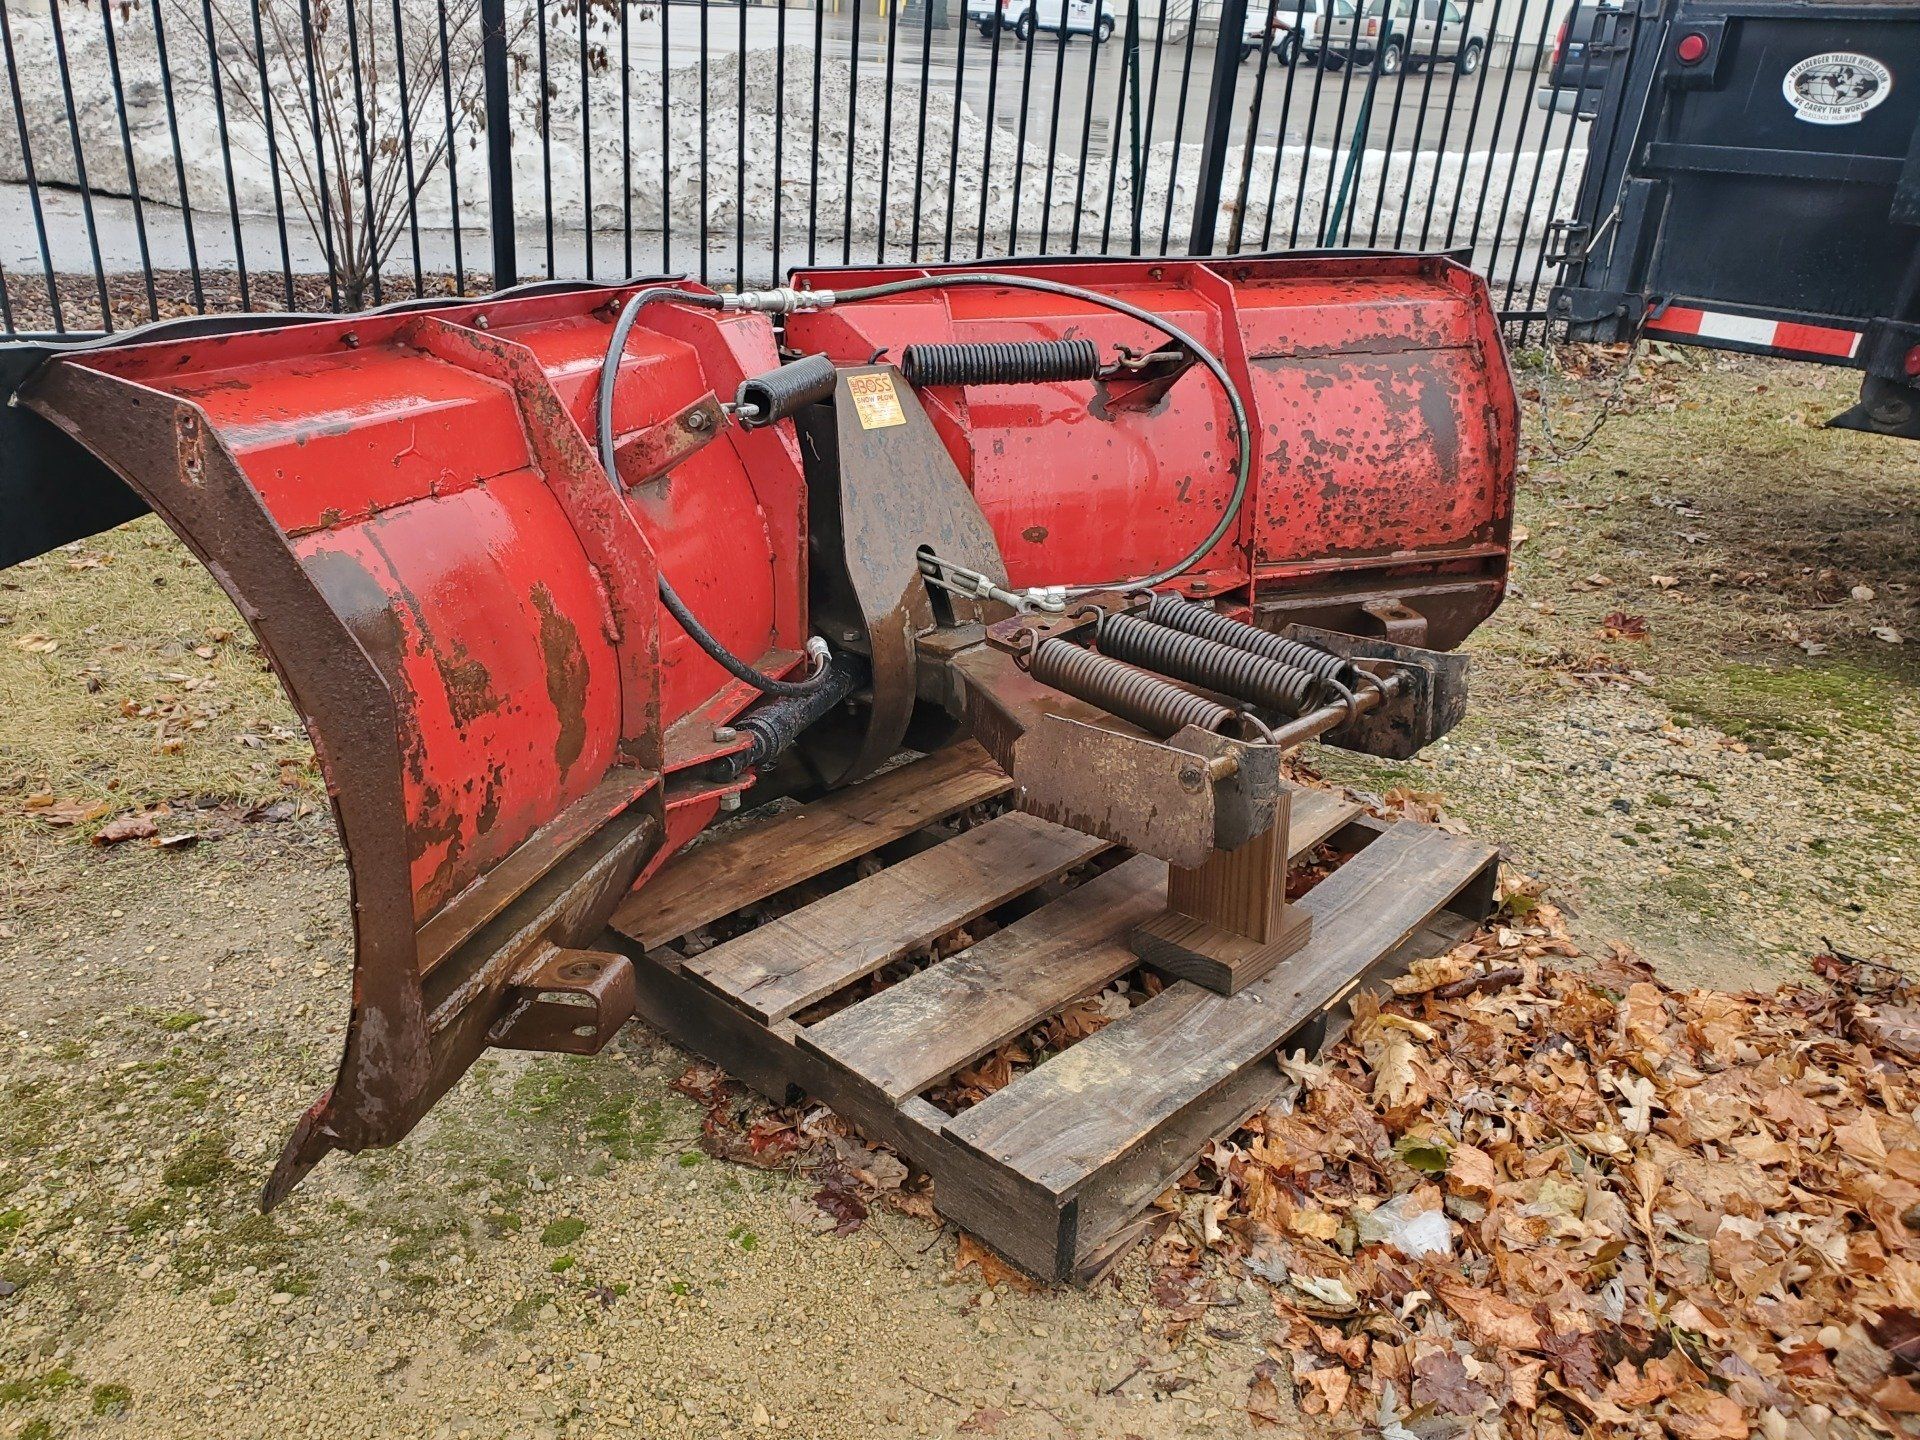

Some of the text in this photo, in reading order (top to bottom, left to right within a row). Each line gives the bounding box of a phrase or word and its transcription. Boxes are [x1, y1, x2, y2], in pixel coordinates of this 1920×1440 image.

[1831, 54, 1857, 65] TRAILER
[1793, 95, 1869, 115] WE CARRY THE WORLD
[851, 376, 892, 395] THE BOSS
[856, 393, 894, 404] SNOW PLOW
